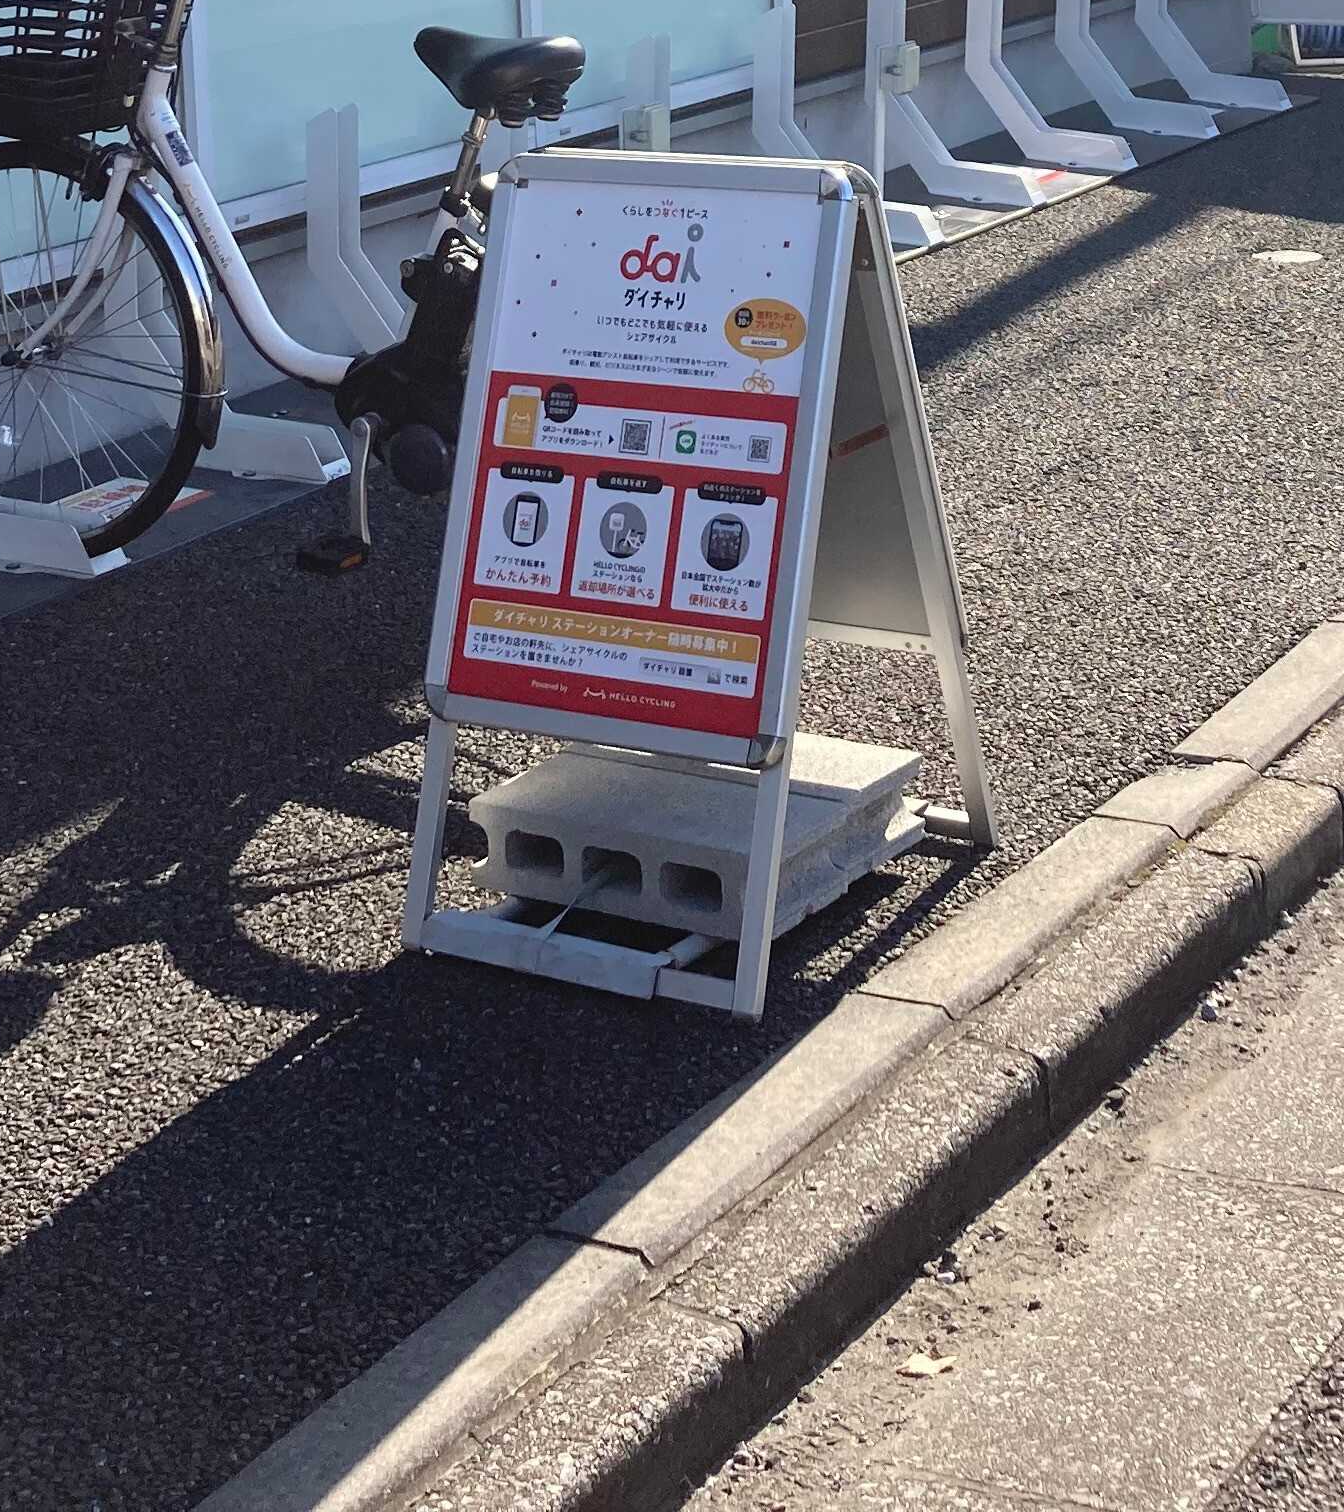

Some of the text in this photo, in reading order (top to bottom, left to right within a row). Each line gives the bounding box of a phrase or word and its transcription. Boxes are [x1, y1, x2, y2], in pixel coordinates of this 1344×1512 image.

[622, 206, 708, 219] くらしをつなぐ1ピース
[620, 223, 704, 283] dai
[625, 288, 685, 310] ダイチャリ
[596, 315, 708, 332] いつでもどこでも気軽に使える
[626, 333, 677, 345] シェアサイクル
[485, 567, 551, 587] かんたん予約
[689, 593, 748, 612] 便利に使える
[494, 609, 548, 628] ダイチャリ
[609, 692, 676, 708] HELLO CYCLING
